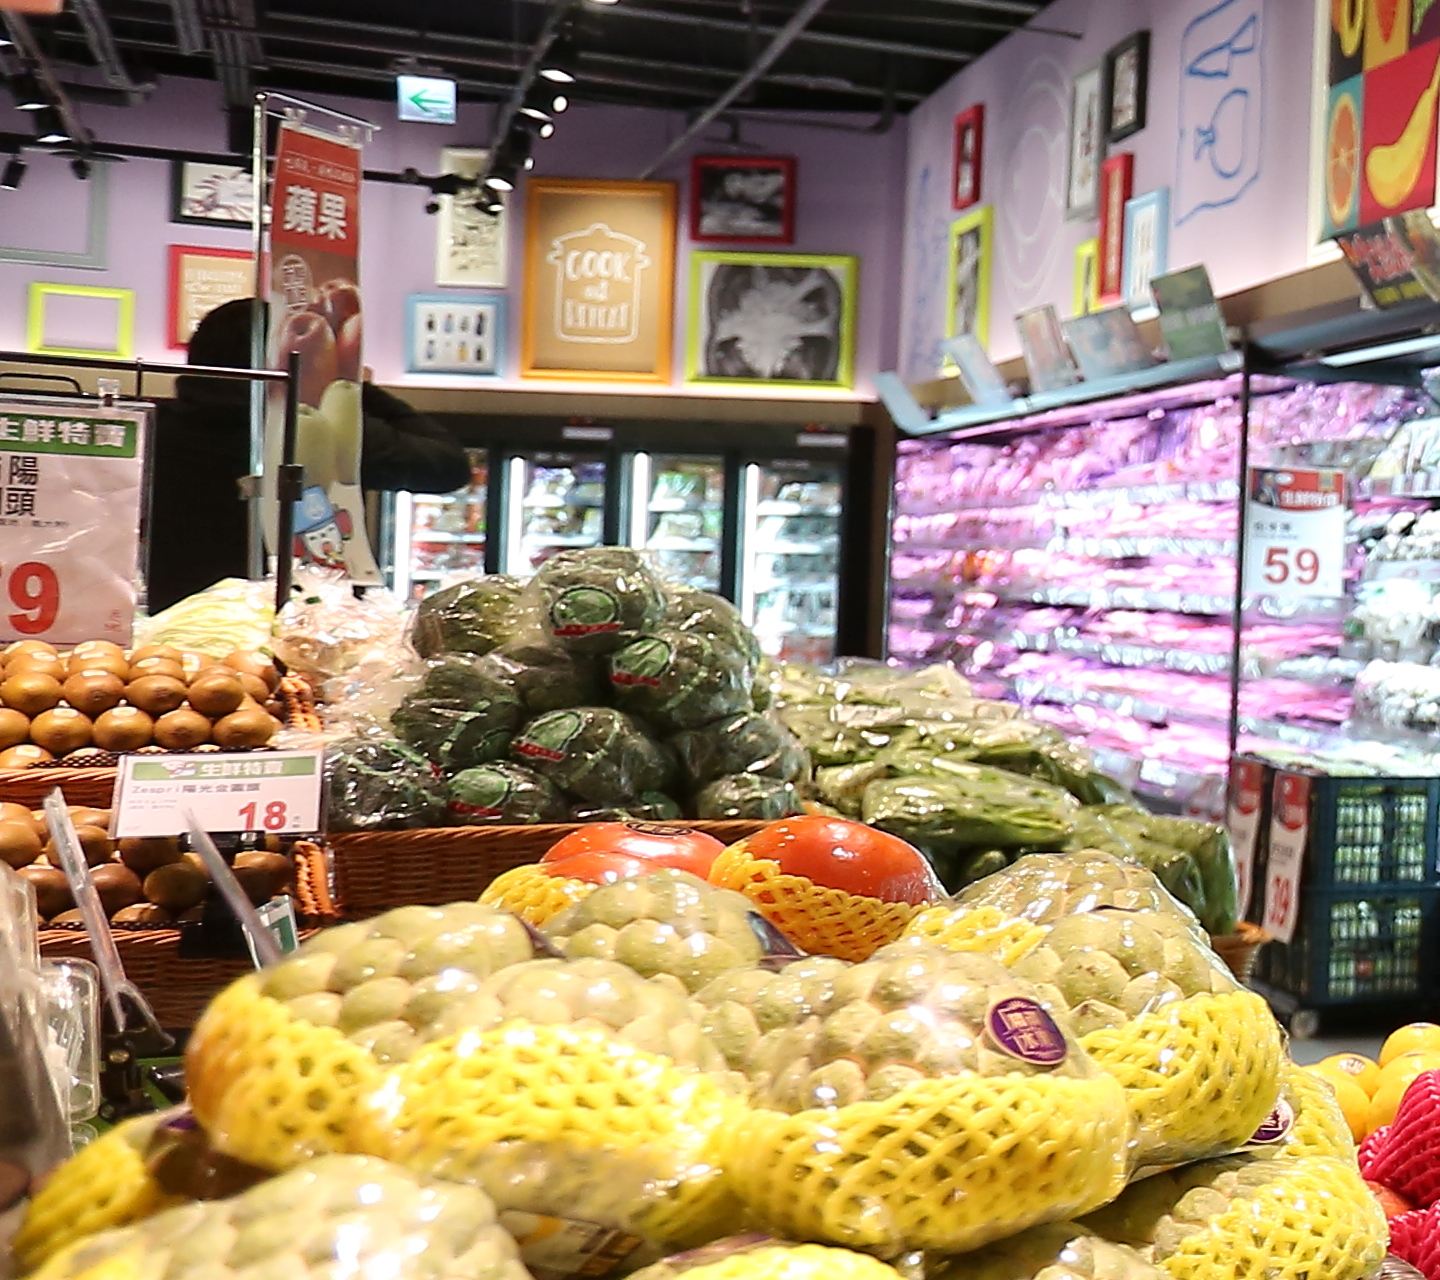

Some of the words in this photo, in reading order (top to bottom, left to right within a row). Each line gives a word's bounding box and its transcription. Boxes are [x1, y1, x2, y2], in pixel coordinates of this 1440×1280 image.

[283, 185, 348, 240] 蘋果
[565, 249, 632, 281] COOK
[1263, 546, 1321, 586] 59
[238, 800, 288, 831] 18
